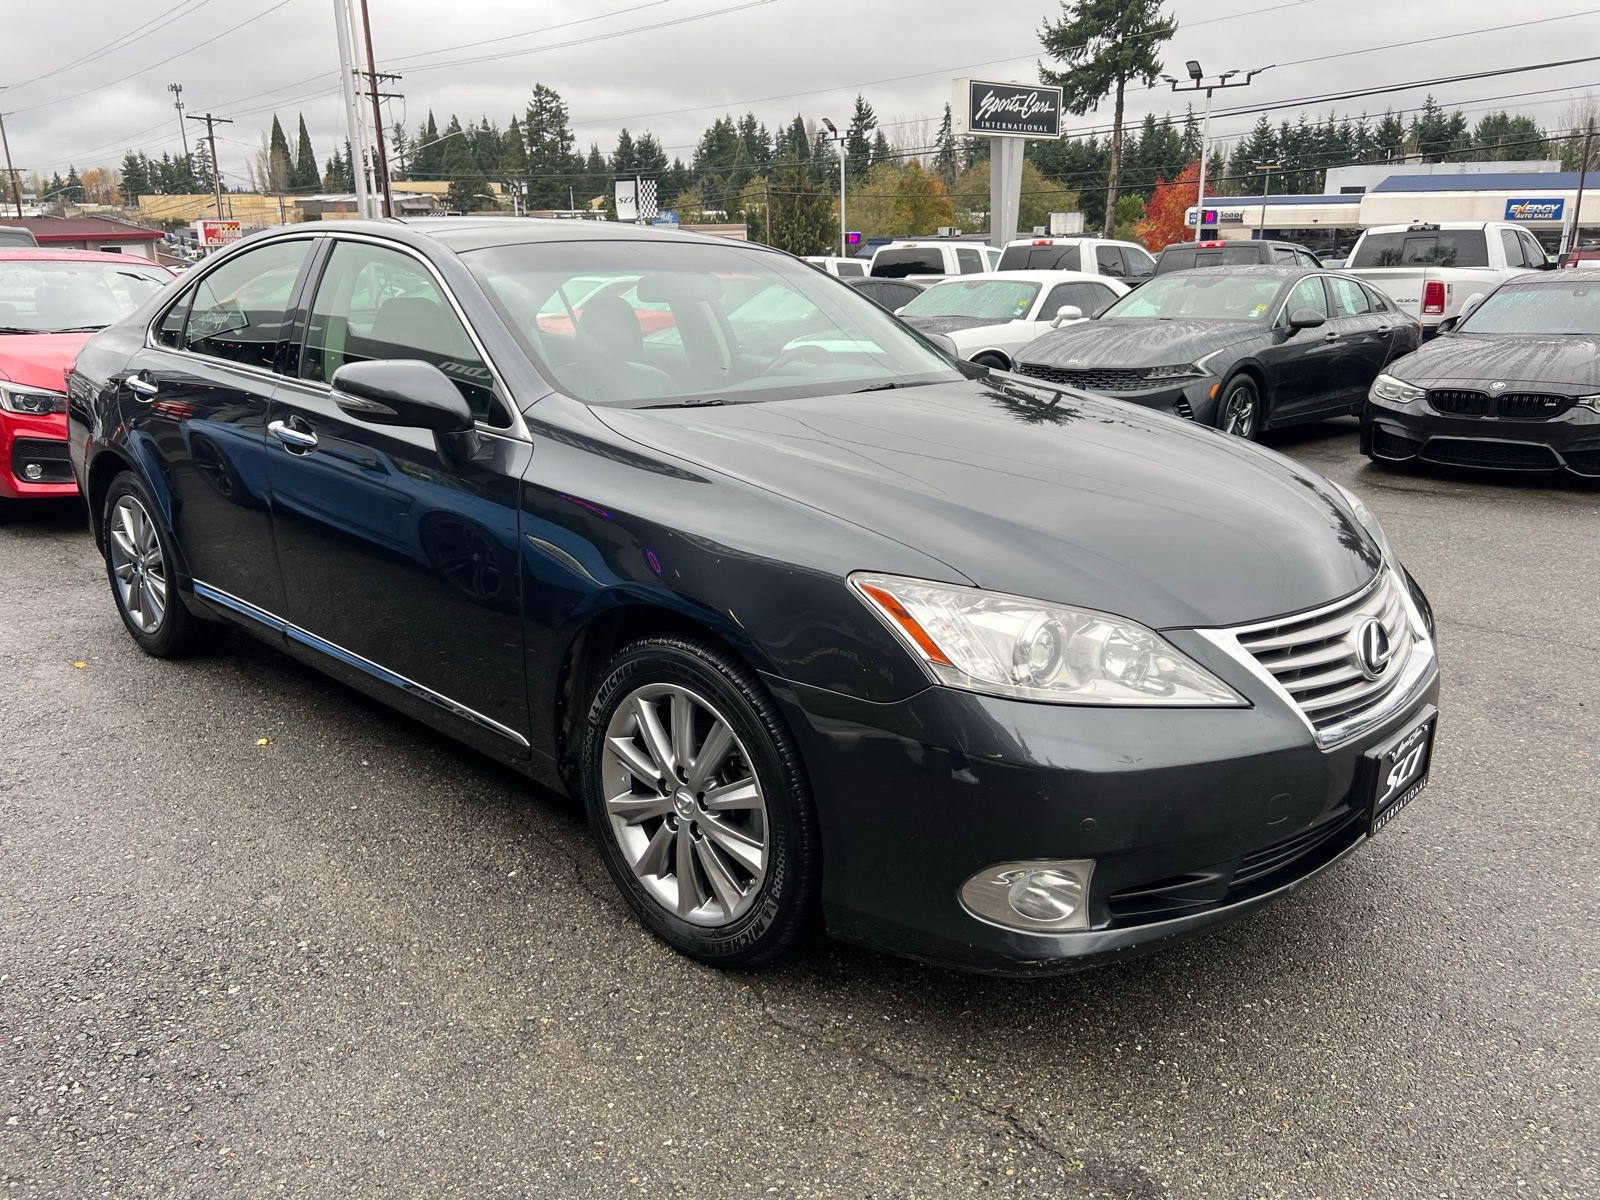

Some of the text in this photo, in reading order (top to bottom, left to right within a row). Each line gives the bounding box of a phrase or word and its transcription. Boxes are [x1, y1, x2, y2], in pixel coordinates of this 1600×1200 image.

[975, 90, 1055, 120] Sports Cars
[981, 121, 1048, 132] INTERNATIONAL
[617, 196, 634, 204] SCI
[1508, 204, 1560, 213] ENERGY
[1373, 778, 1427, 834] INTERNATIONAL
